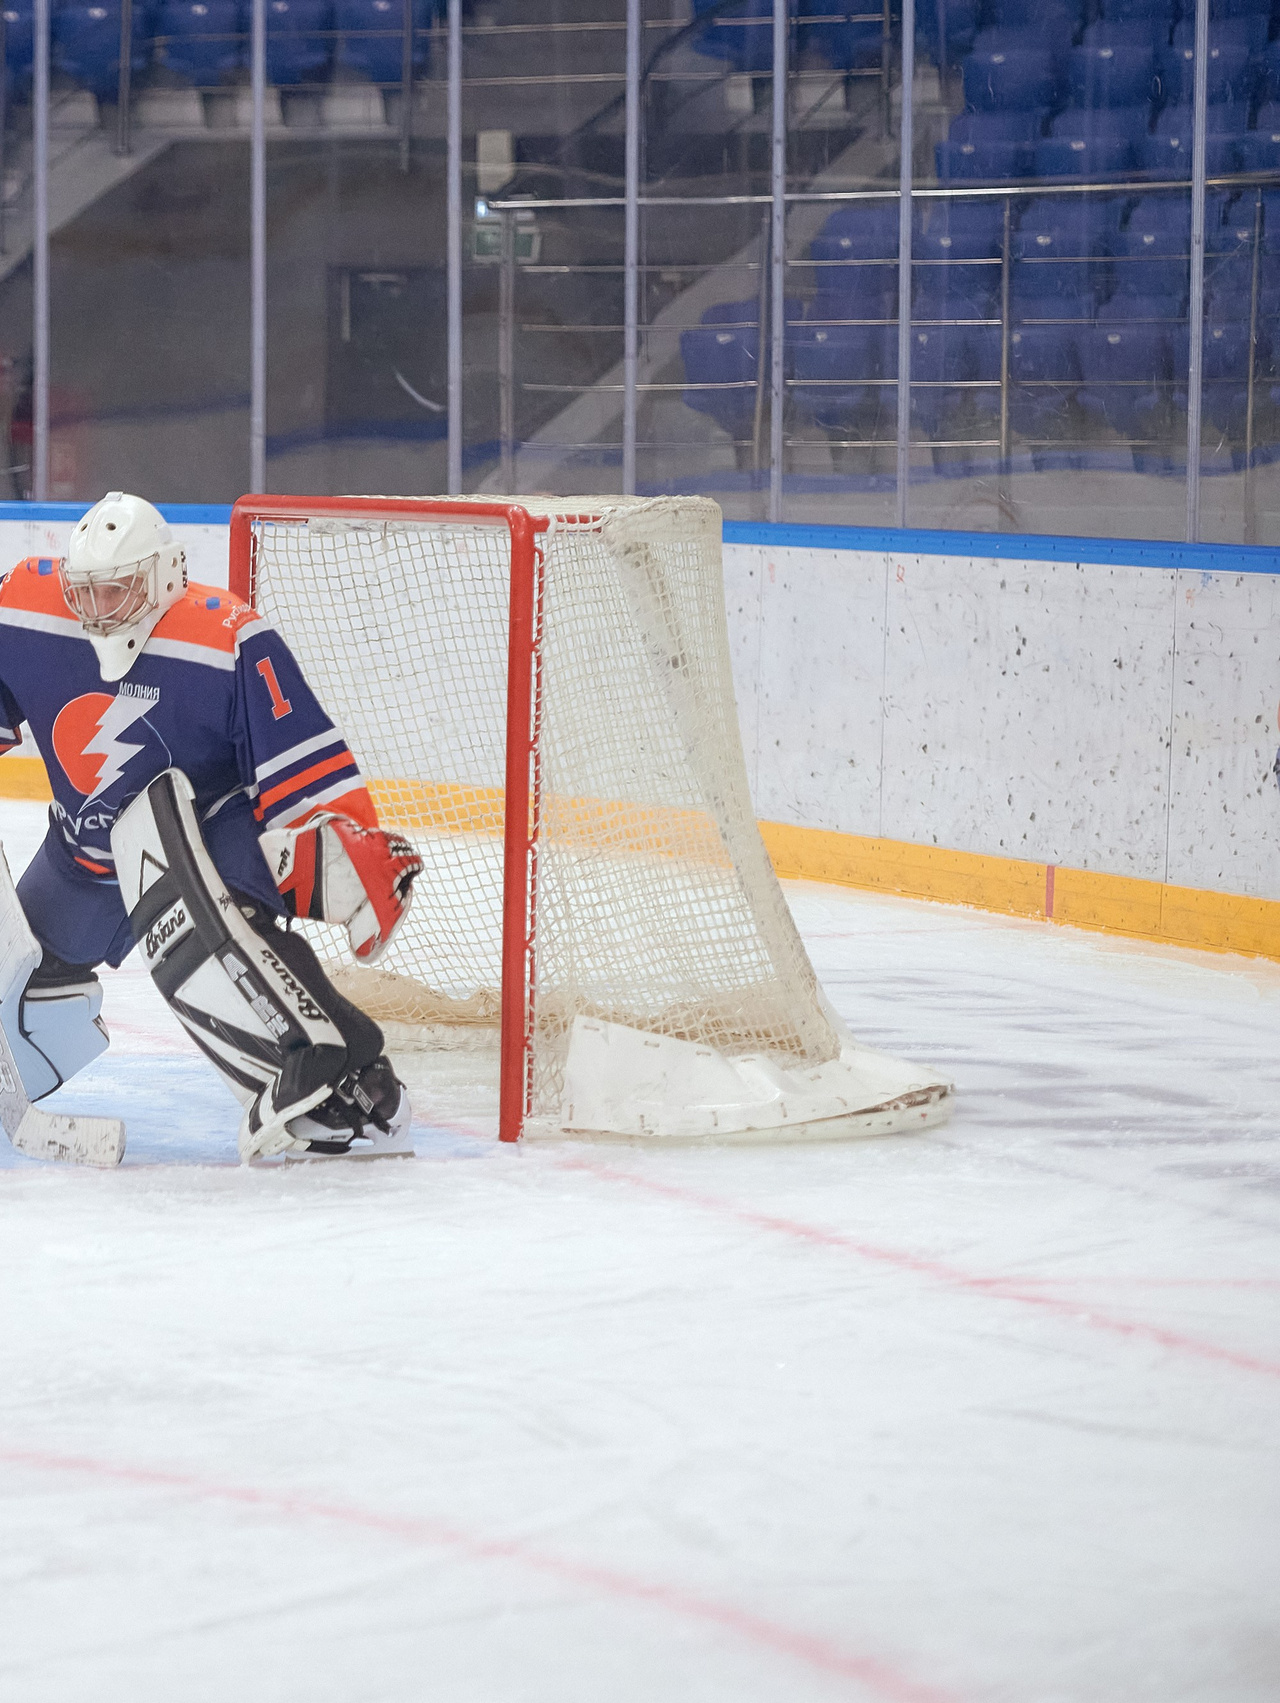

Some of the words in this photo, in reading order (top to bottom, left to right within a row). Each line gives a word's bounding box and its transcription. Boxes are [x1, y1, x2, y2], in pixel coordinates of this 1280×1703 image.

[119, 681, 160, 700] МОЛНИЯ
[256, 656, 293, 721] 1
[146, 908, 187, 959] Brian's
[261, 949, 330, 1024] Brian's
